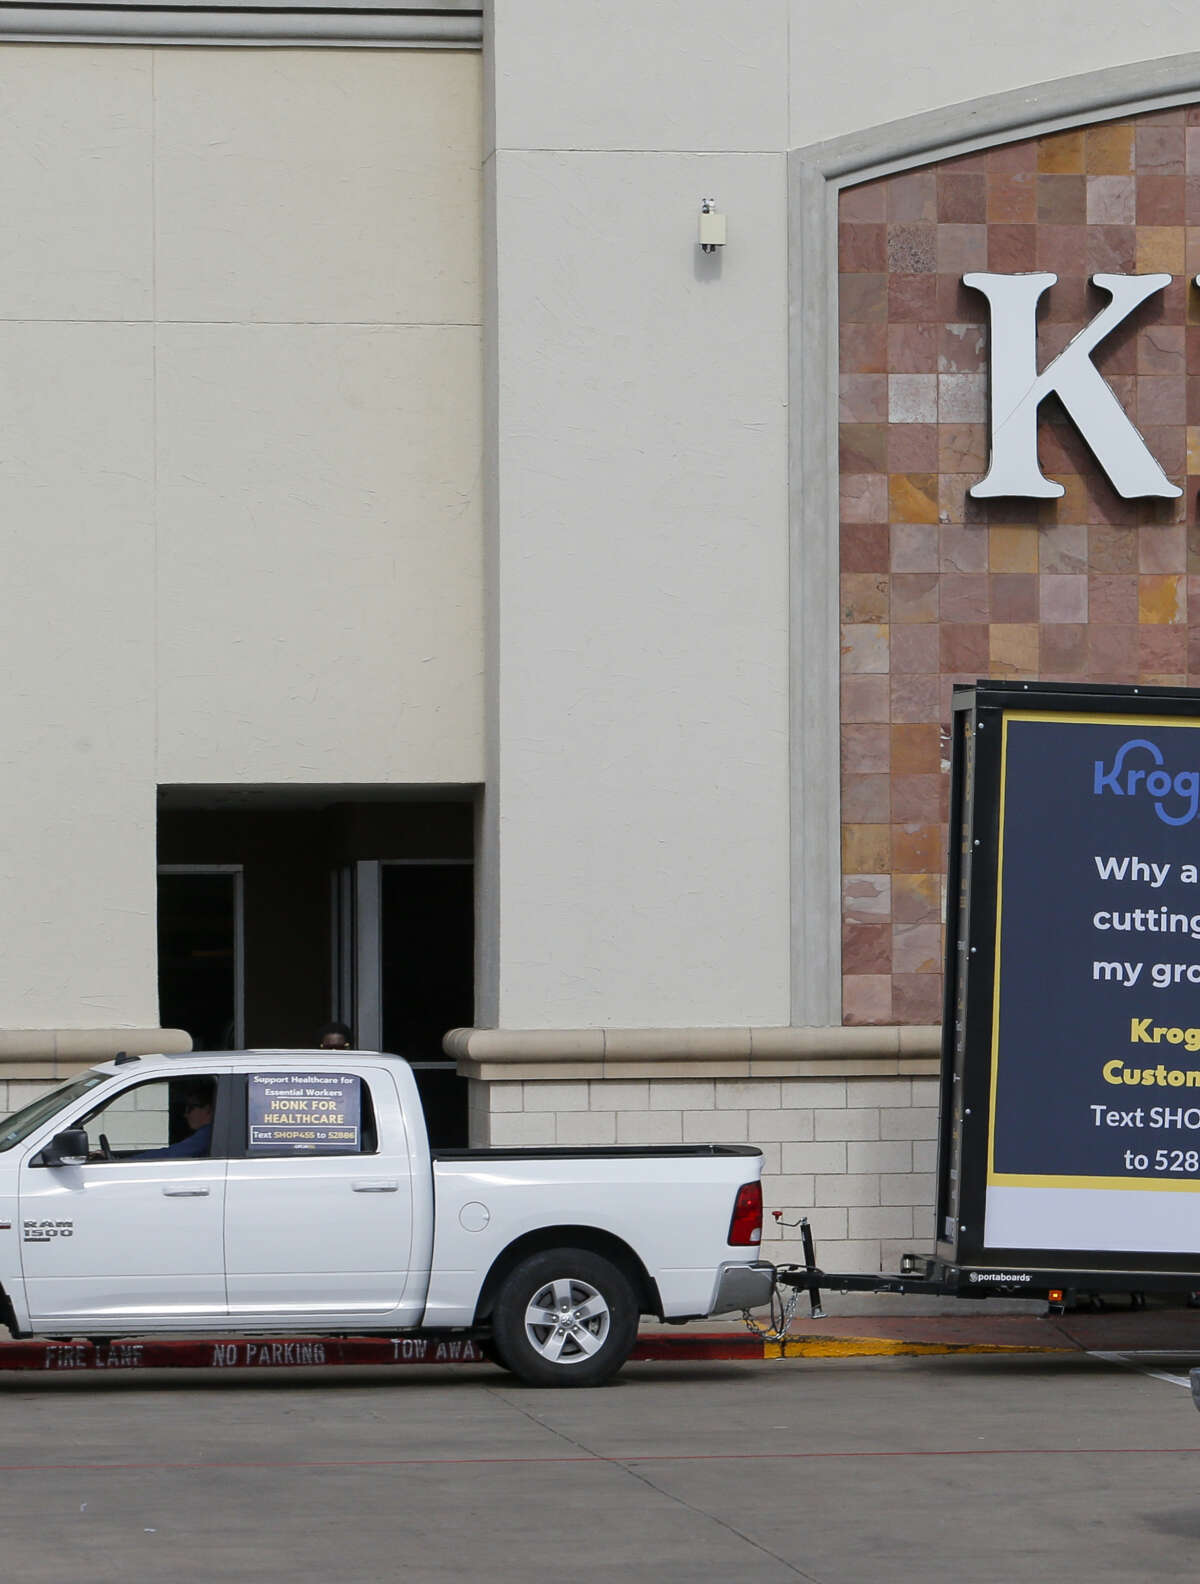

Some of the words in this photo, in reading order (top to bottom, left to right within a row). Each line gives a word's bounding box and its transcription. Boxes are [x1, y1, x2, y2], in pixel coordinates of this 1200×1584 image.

[1095, 857, 1170, 887] Why
[1092, 961, 1143, 987] my
[254, 1076, 289, 1085] Support
[291, 1076, 338, 1084] Healthcare
[306, 1089, 342, 1097] Workers
[271, 1101, 308, 1110] HONK
[312, 1101, 336, 1110] FOR
[264, 1114, 345, 1123] HEALTHCARE
[1090, 1104, 1144, 1127] Text
[254, 1131, 272, 1139] Text
[317, 1131, 326, 1139] to
[1124, 1150, 1149, 1170] to
[24, 1229, 73, 1237] 1500
[977, 1272, 1031, 1282] portaboards
[390, 1338, 428, 1360] TOW
[435, 1340, 484, 1360] AWA
[212, 1343, 237, 1367] NO
[246, 1342, 326, 1365] PARKING
